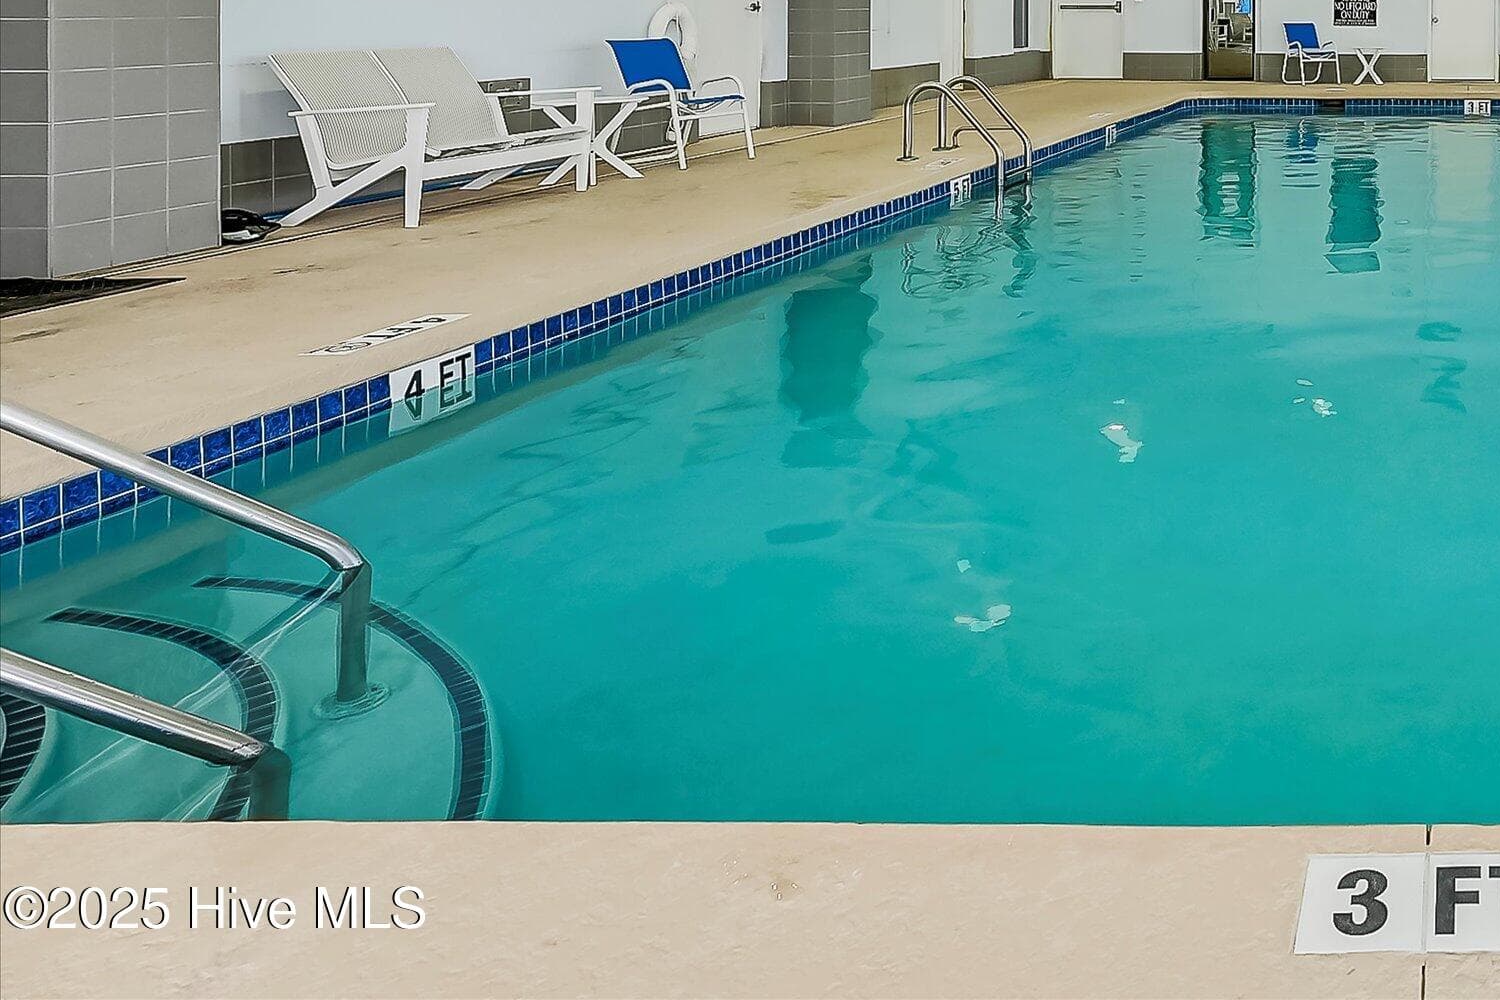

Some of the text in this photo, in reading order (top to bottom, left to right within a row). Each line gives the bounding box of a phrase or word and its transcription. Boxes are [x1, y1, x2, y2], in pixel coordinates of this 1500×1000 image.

[404, 352, 472, 400] 4 FT
[1332, 869, 1389, 937] 3
